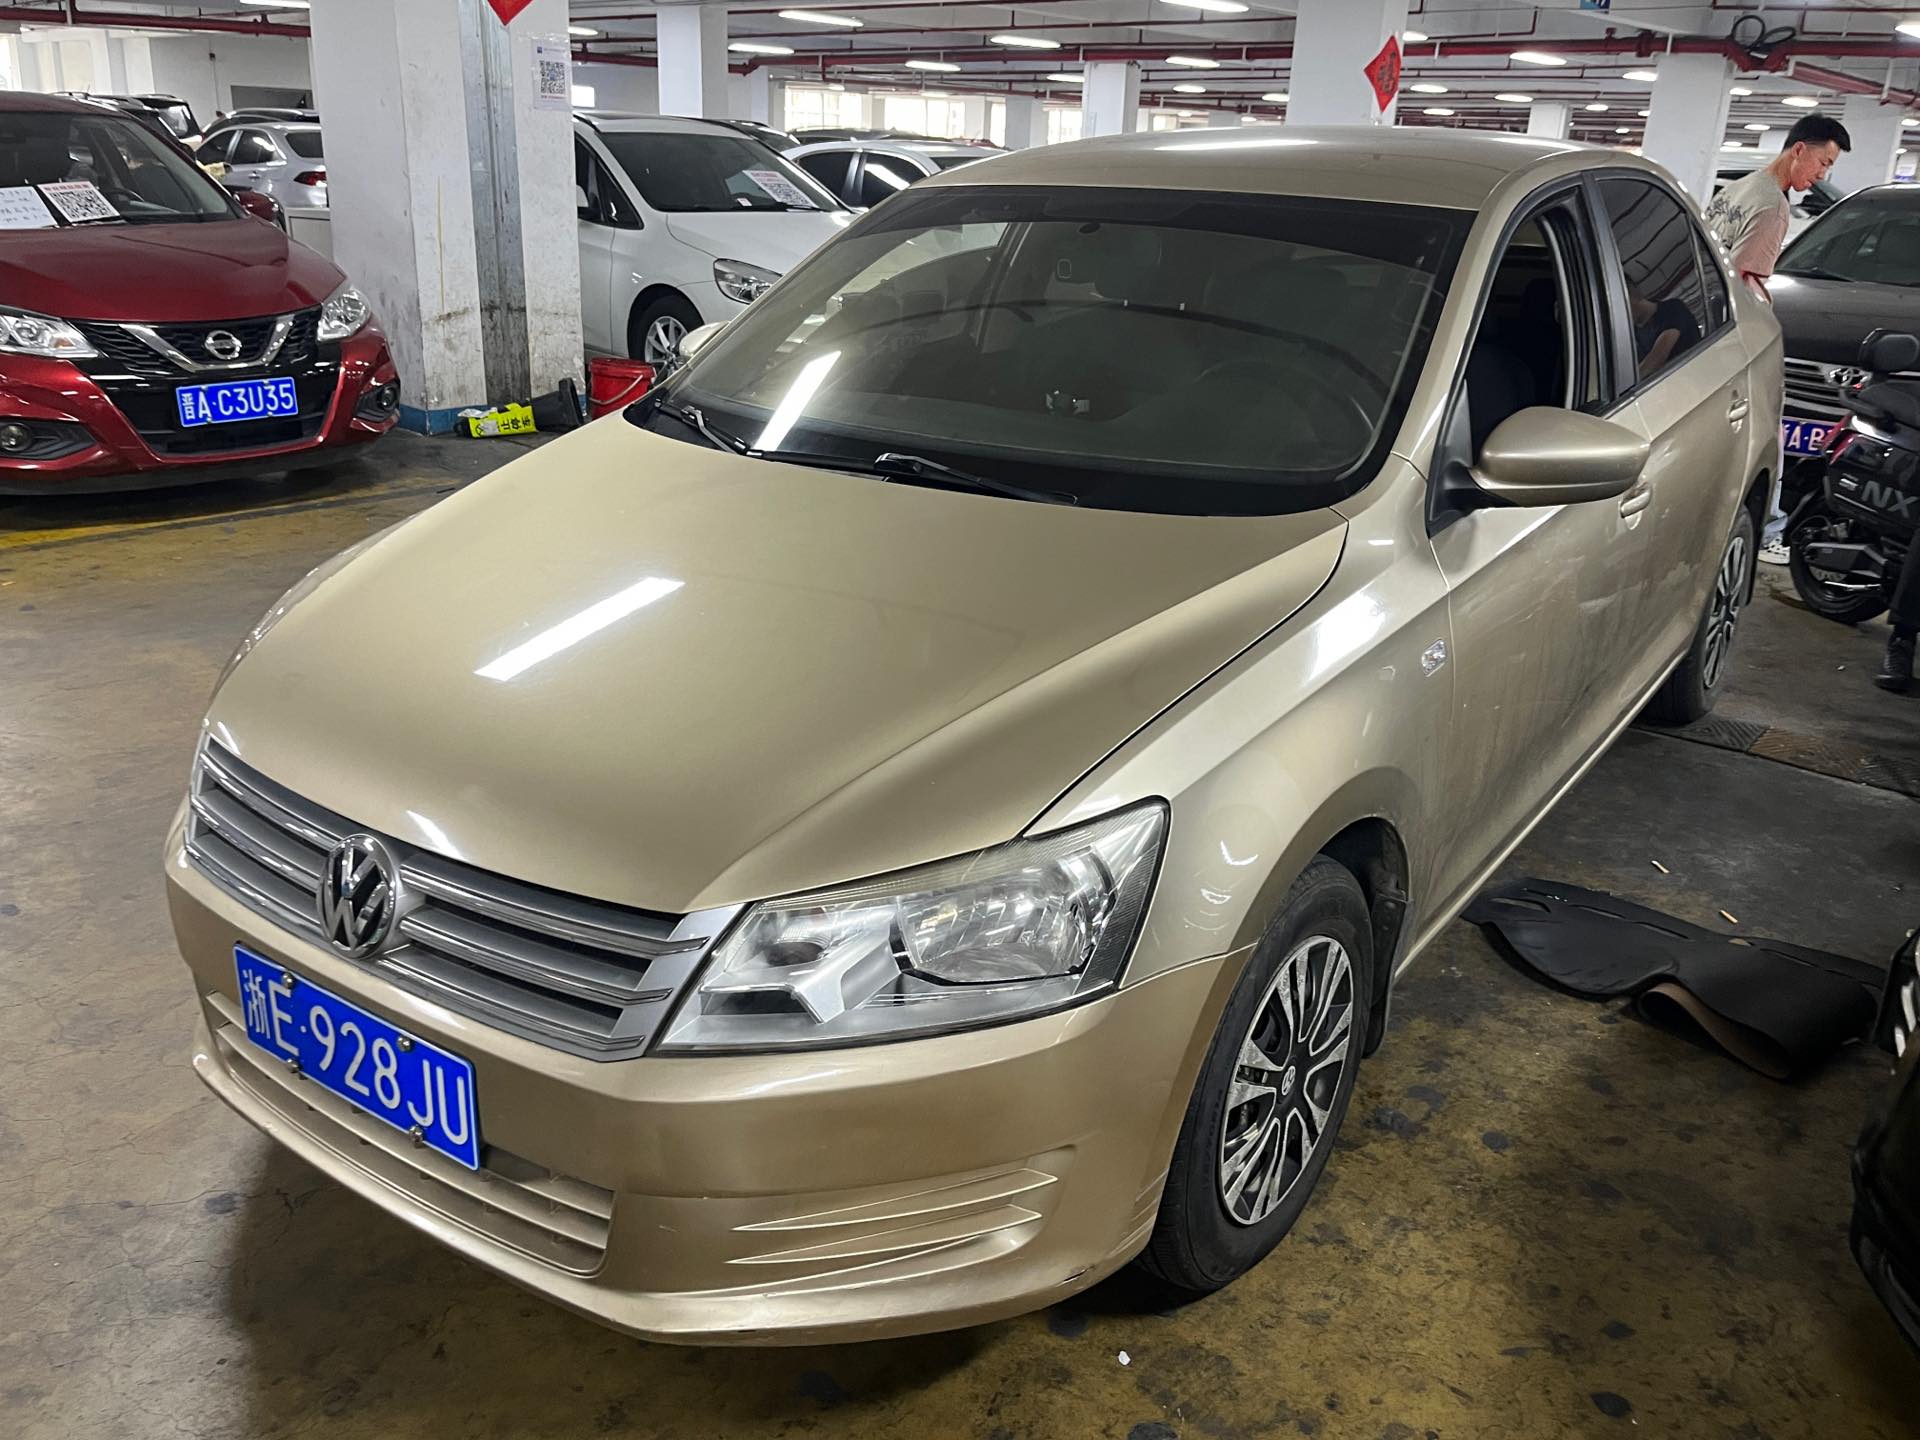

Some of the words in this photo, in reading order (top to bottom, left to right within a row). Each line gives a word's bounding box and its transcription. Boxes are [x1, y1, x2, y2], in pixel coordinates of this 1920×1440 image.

[181, 383, 294, 420] 晋A·C3U35
[1861, 480, 1919, 518] NX
[242, 968, 470, 1147] 浙E·928JU
